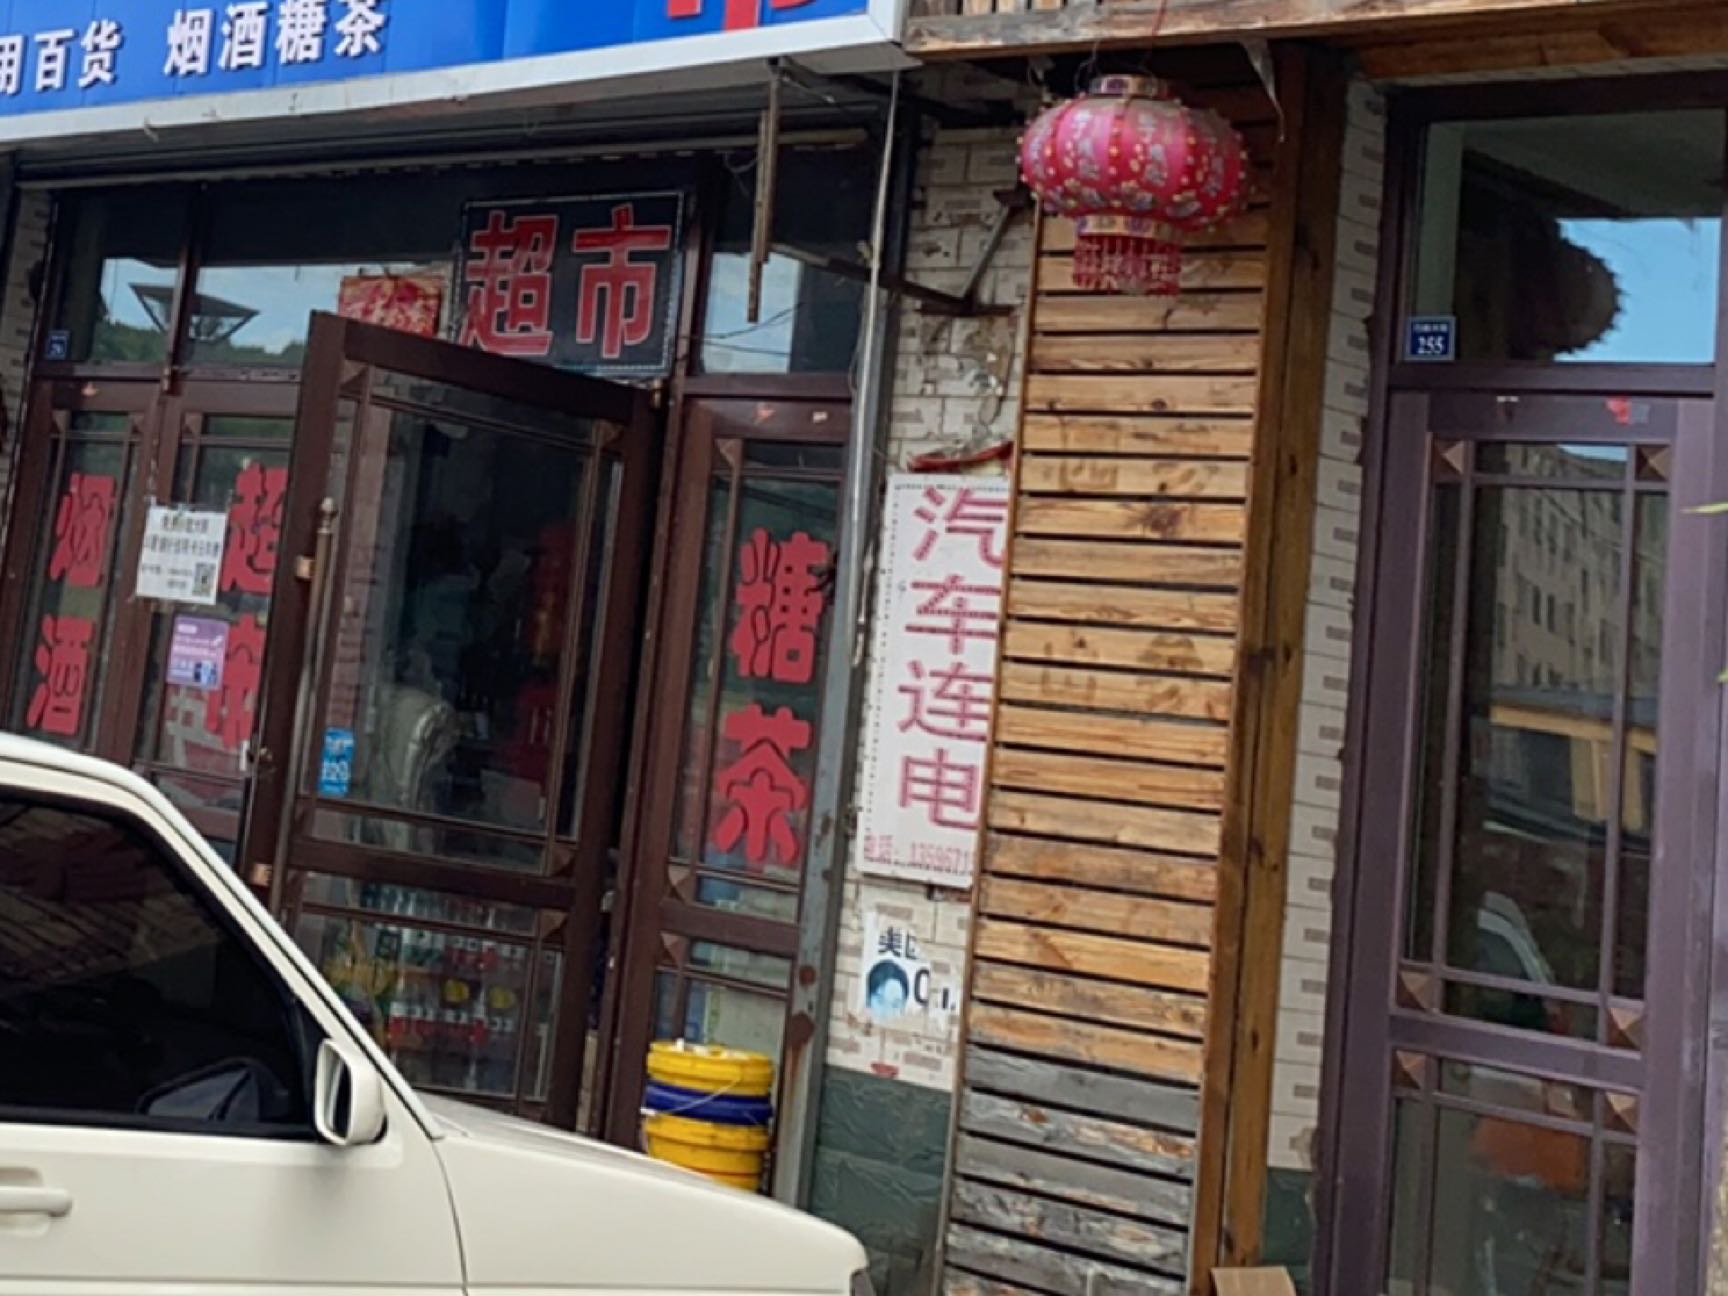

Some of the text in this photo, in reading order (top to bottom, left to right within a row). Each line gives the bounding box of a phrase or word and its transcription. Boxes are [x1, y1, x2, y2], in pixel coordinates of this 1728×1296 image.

[459, 204, 672, 360] 超市
[712, 527, 829, 863] 糖茶
[897, 486, 1010, 831] 汽车连电
